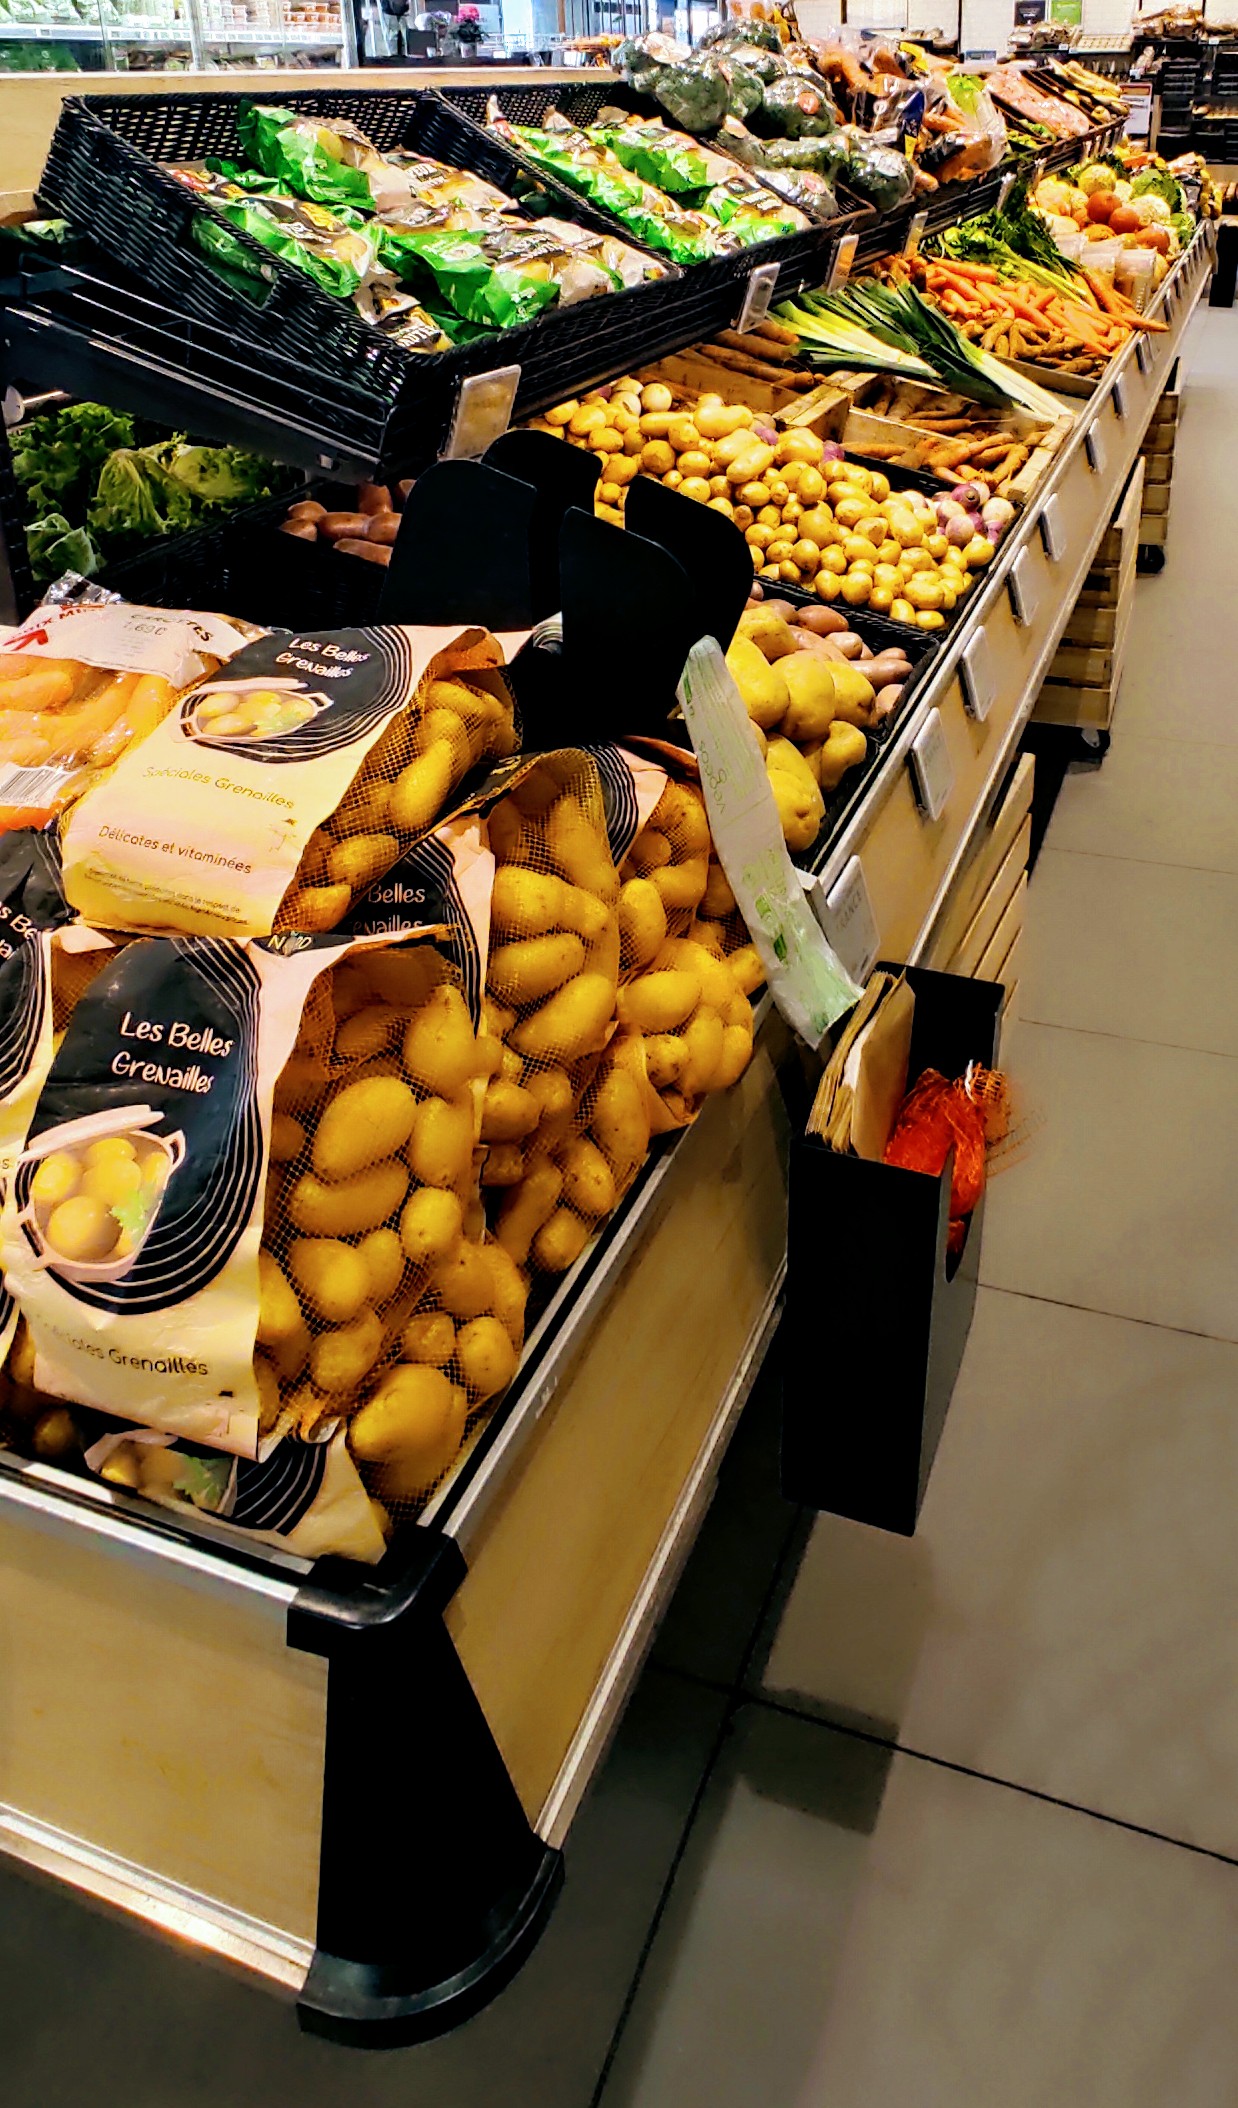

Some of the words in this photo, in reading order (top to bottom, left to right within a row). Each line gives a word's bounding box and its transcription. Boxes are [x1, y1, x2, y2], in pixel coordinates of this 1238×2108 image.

[288, 638, 321, 652] Les
[321, 644, 371, 663] Belles
[142, 766, 212, 785] Spéciales
[214, 777, 295, 809] Grenailles
[98, 825, 159, 850] Délicates
[161, 841, 175, 855] et
[178, 846, 252, 874] vitaminées
[368, 883, 426, 903] Belles
[120, 1011, 164, 1042] Les
[168, 1022, 235, 1057] Belles
[109, 1349, 208, 1375] Grenailles
